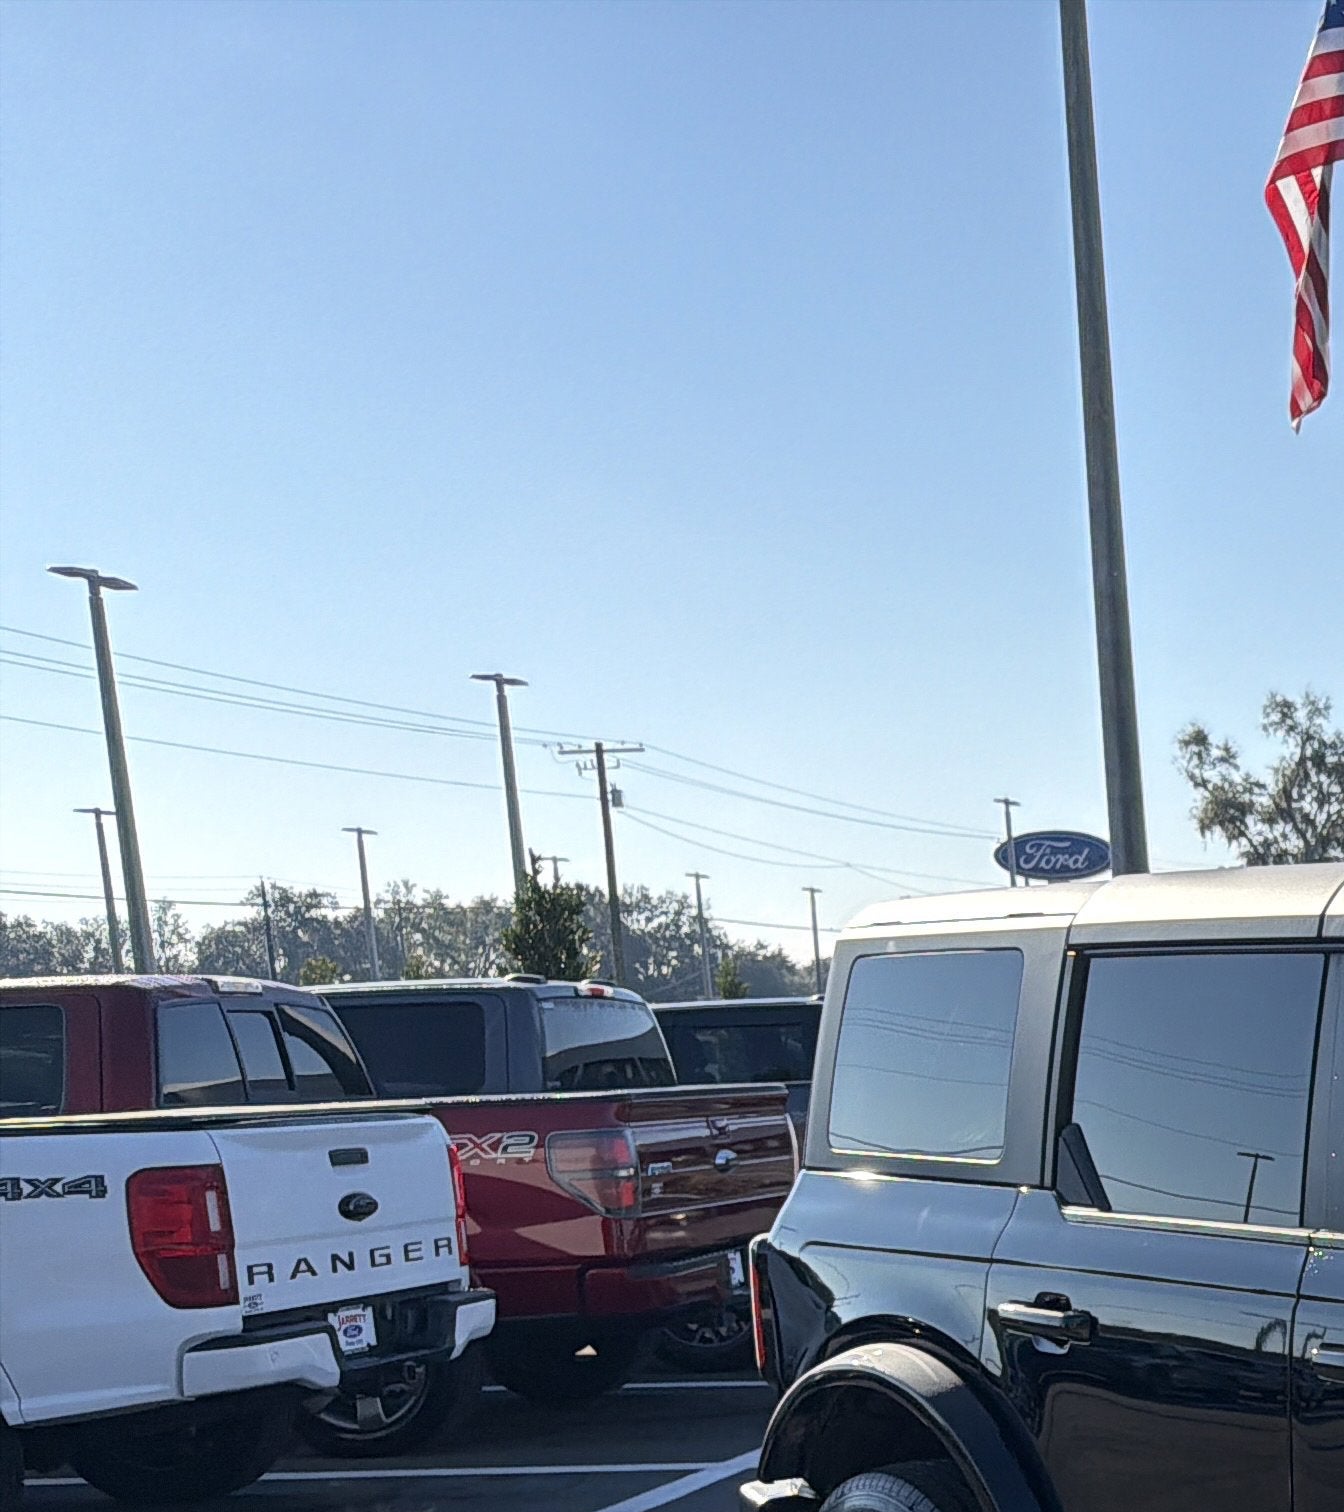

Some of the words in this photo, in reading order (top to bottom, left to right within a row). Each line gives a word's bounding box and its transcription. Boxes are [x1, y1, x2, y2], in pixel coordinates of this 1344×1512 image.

[1019, 840, 1090, 870] Ford
[450, 1131, 539, 1160] X2
[246, 1236, 454, 1286] RANGER
